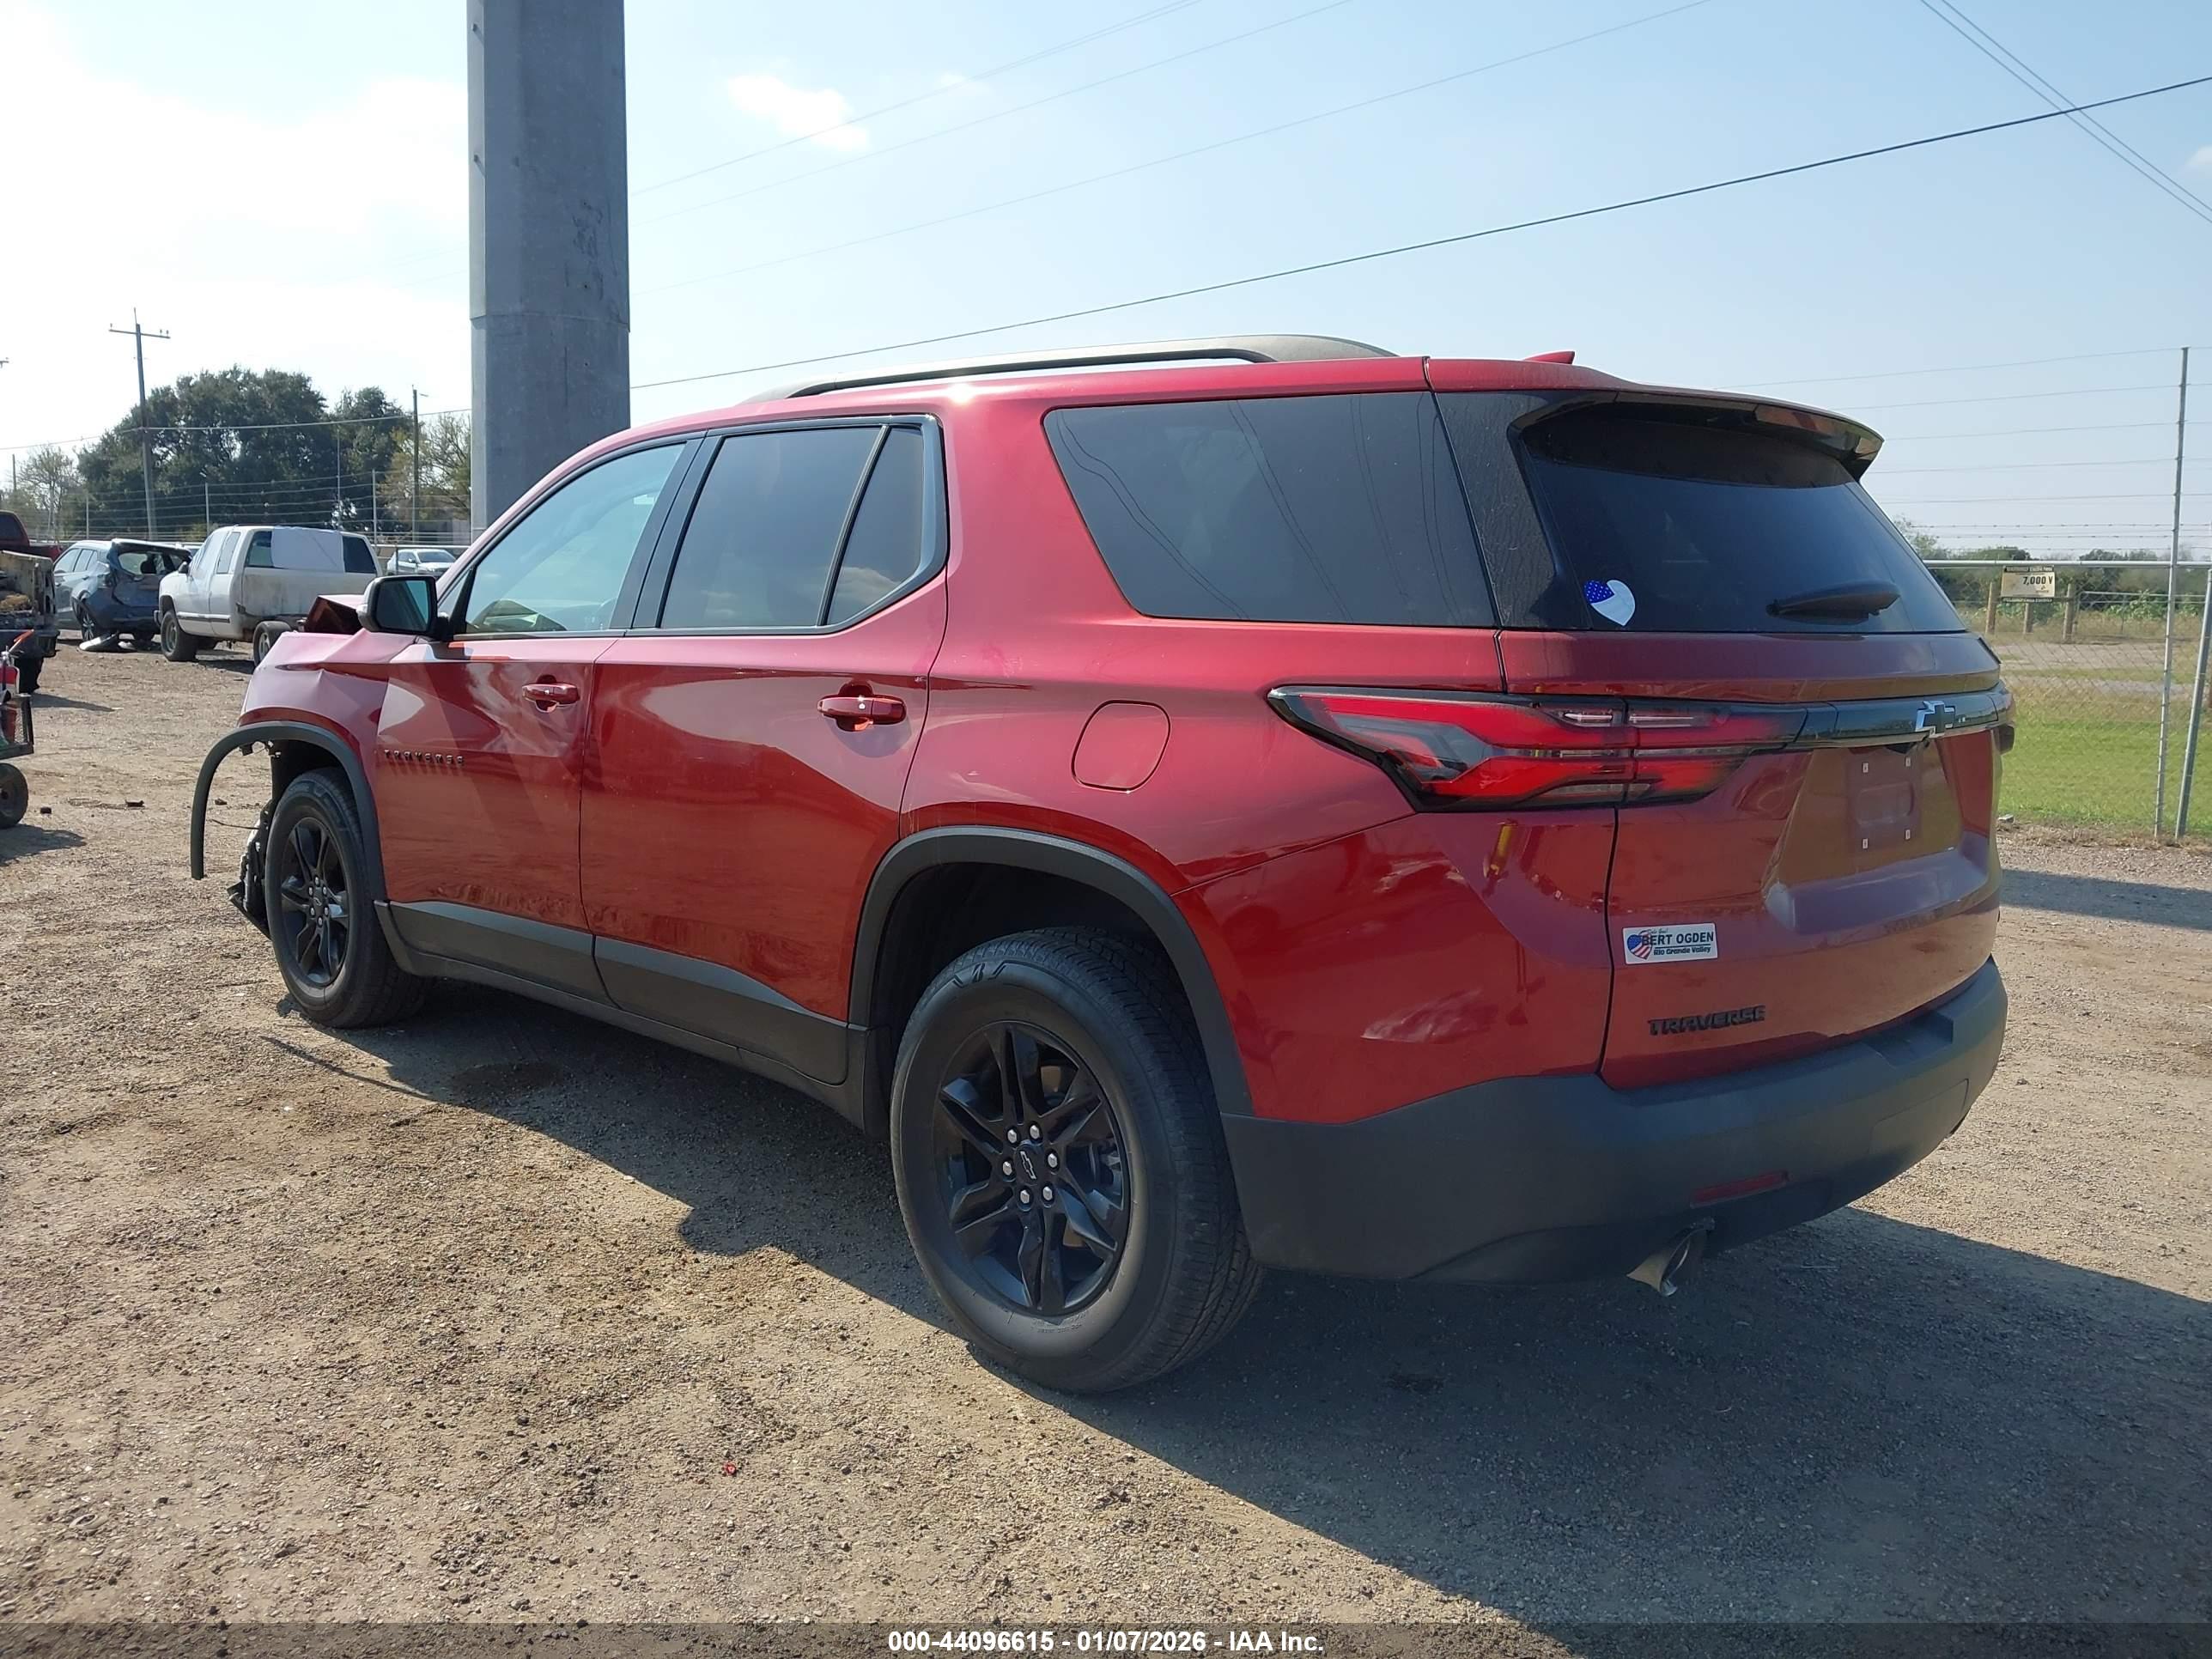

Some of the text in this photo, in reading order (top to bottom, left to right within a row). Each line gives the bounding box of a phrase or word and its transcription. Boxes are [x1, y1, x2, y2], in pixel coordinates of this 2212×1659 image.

[2023, 576, 2046, 585] 7,000
[1641, 932, 1714, 945] BERT OGDEN
[1647, 1005, 1765, 1036] TRAVERSE
